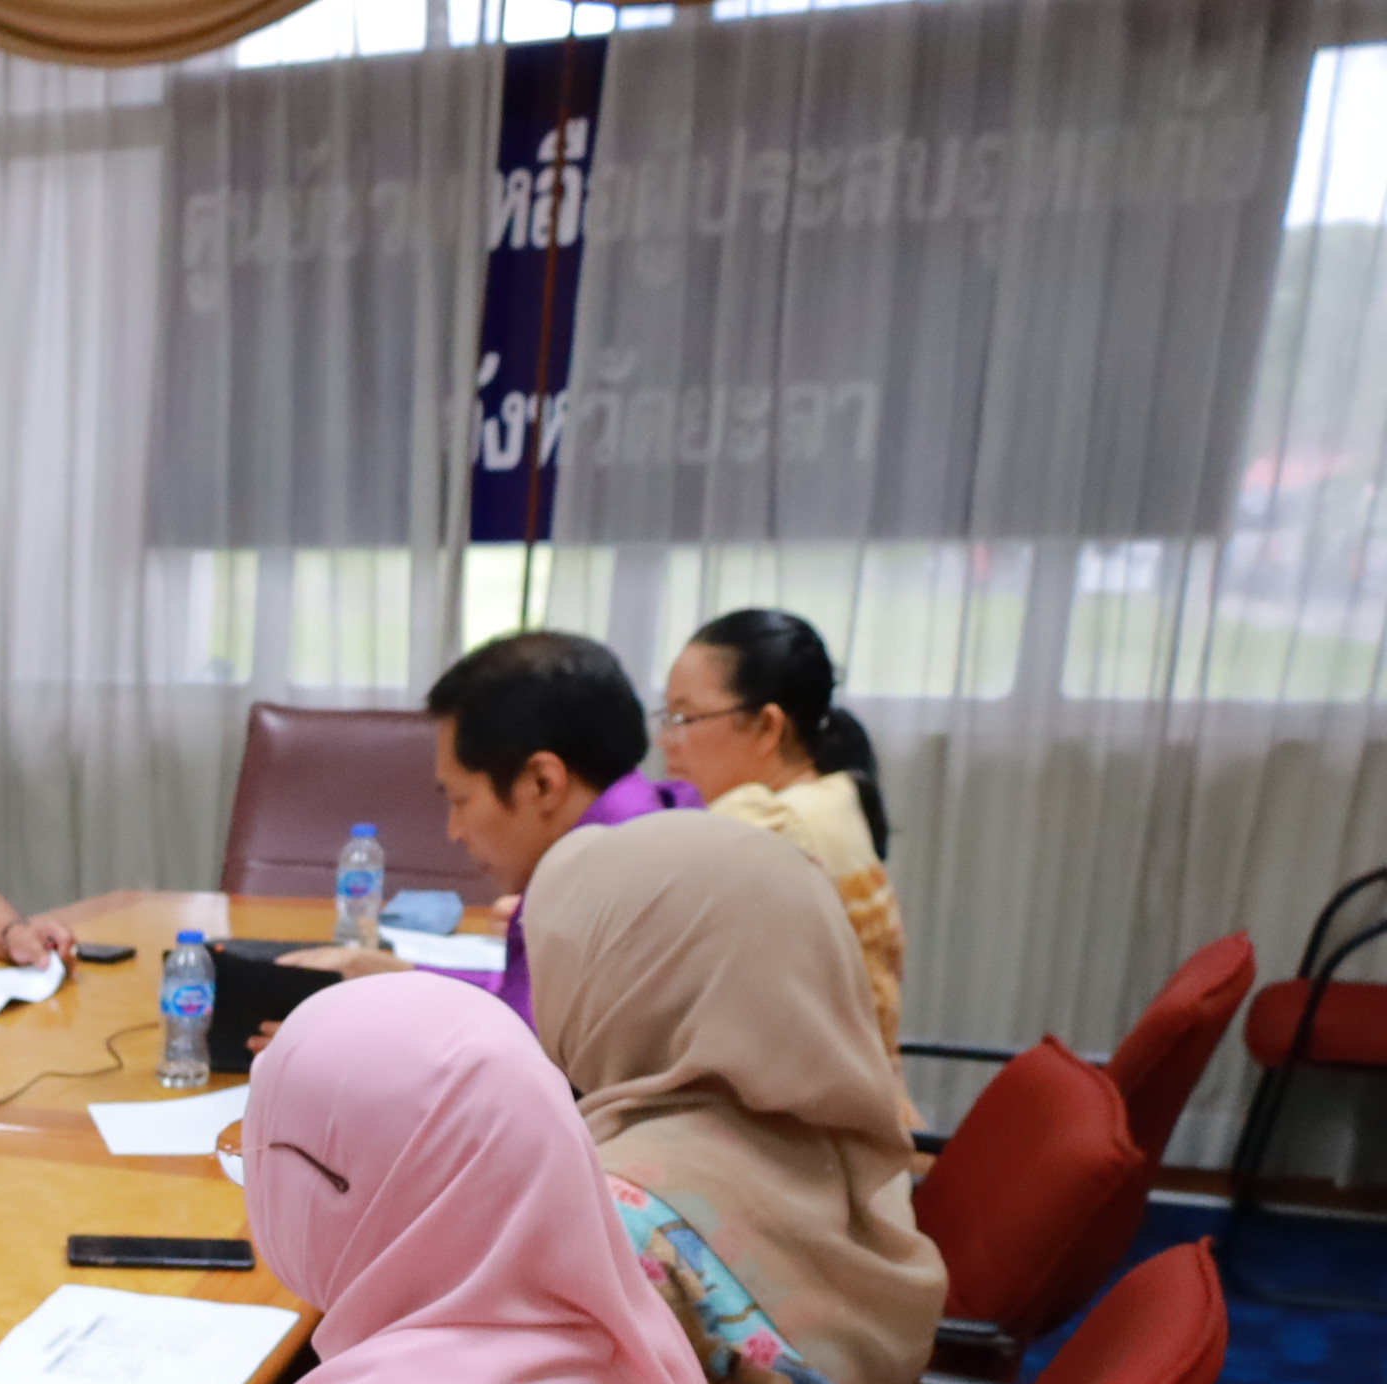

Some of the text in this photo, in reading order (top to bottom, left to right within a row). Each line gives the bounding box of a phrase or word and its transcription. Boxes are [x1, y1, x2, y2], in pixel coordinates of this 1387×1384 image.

[183, 68, 1267, 312] ศูนย์ชวหลือผู้ประสบอุทกภัย
